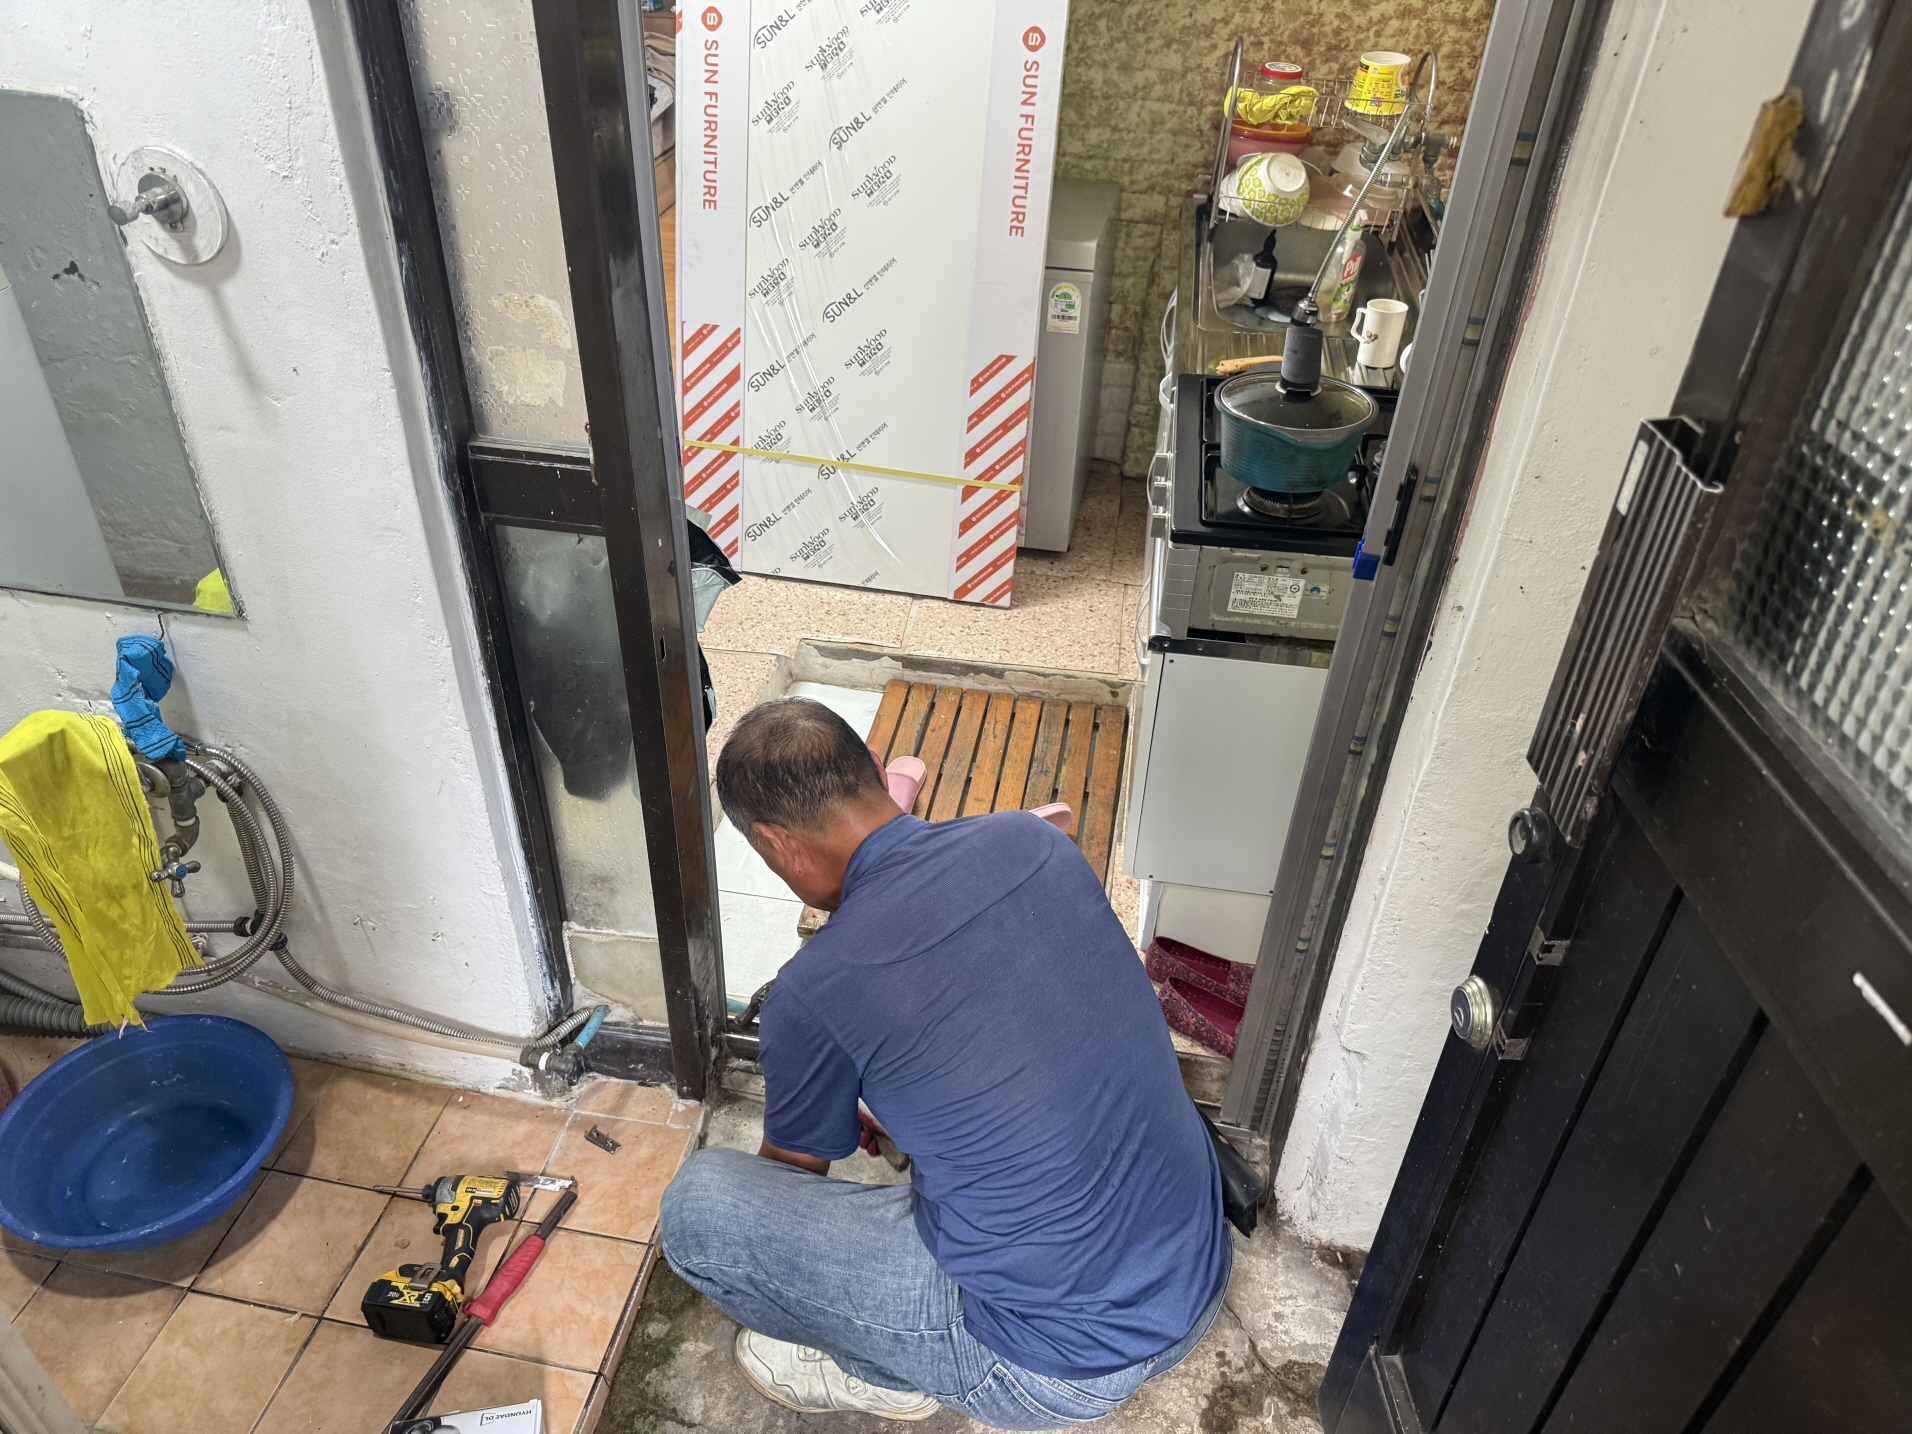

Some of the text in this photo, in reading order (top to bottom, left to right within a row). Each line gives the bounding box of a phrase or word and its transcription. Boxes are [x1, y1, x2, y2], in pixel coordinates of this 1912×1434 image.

[756, 9, 796, 49] SUN&L
[832, 111, 872, 151] SUN&L
[885, 77, 908, 100] 인테리어
[703, 39, 719, 210] SUN FURNITURE
[1009, 59, 1040, 237] SUN FURNITURE
[751, 191, 790, 228] SUN&L
[802, 160, 823, 181] 인테리어
[825, 287, 864, 323] SUN&L
[877, 257, 898, 278] 인테리어
[696, 363, 711, 378] FURNITURE
[989, 357, 1007, 374] FURNITURE
[750, 359, 786, 393] SUN&L
[1010, 373, 1029, 389] FURNITURE
[868, 421, 889, 440] 인테리어
[985, 429, 1003, 444] FURNITURE
[1005, 446, 1023, 462] FURNITURE
[711, 456, 726, 471] FURNITURE
[747, 512, 783, 542] SUN&L
[794, 487, 813, 505] 인테리어
[981, 499, 999, 514] FURNITURE
[998, 517, 1016, 532] FURNITURE
[977, 566, 994, 580] FURNITURE
[993, 584, 1010, 599] FURNITURE
[423, 1292, 433, 1301] 5
[495, 1409, 532, 1420] HYUNDAE
